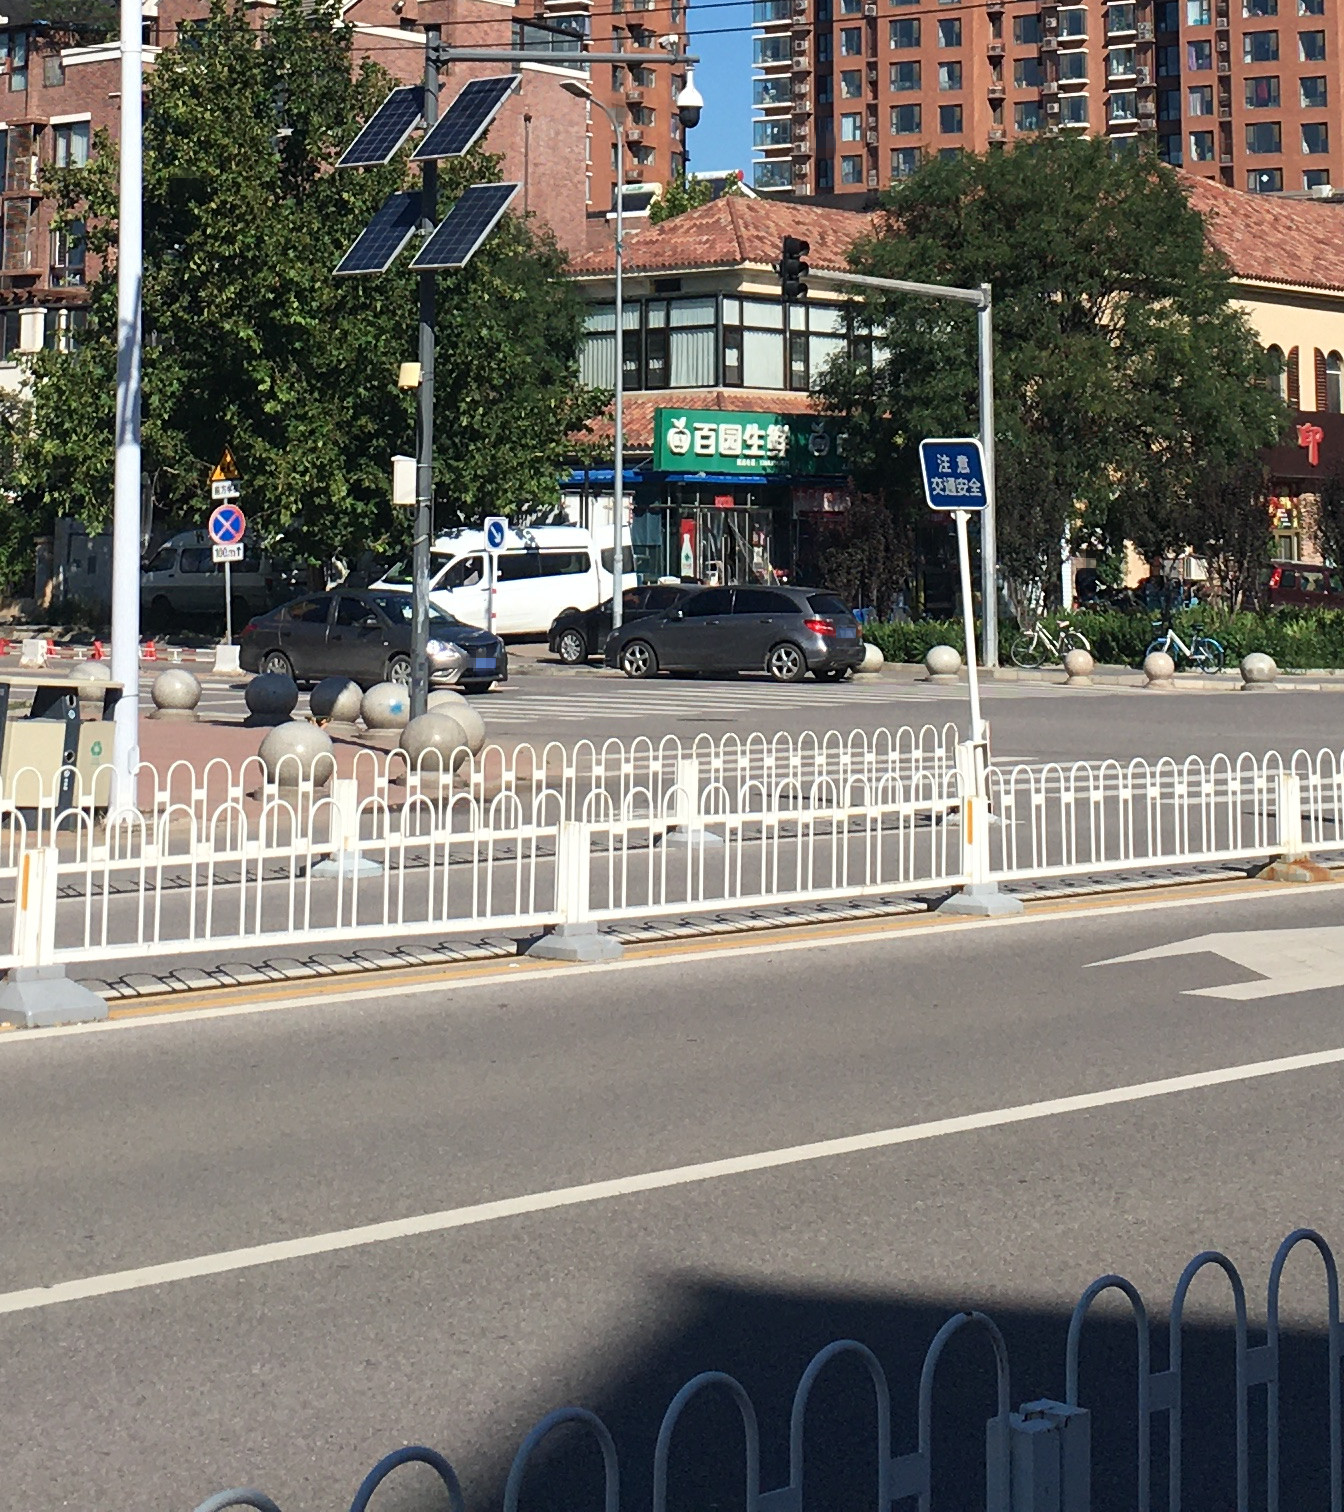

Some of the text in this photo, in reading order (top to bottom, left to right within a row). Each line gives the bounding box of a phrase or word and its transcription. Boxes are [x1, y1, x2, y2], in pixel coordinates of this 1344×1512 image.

[936, 453, 971, 474] 注意
[930, 476, 982, 497] 交通安全
